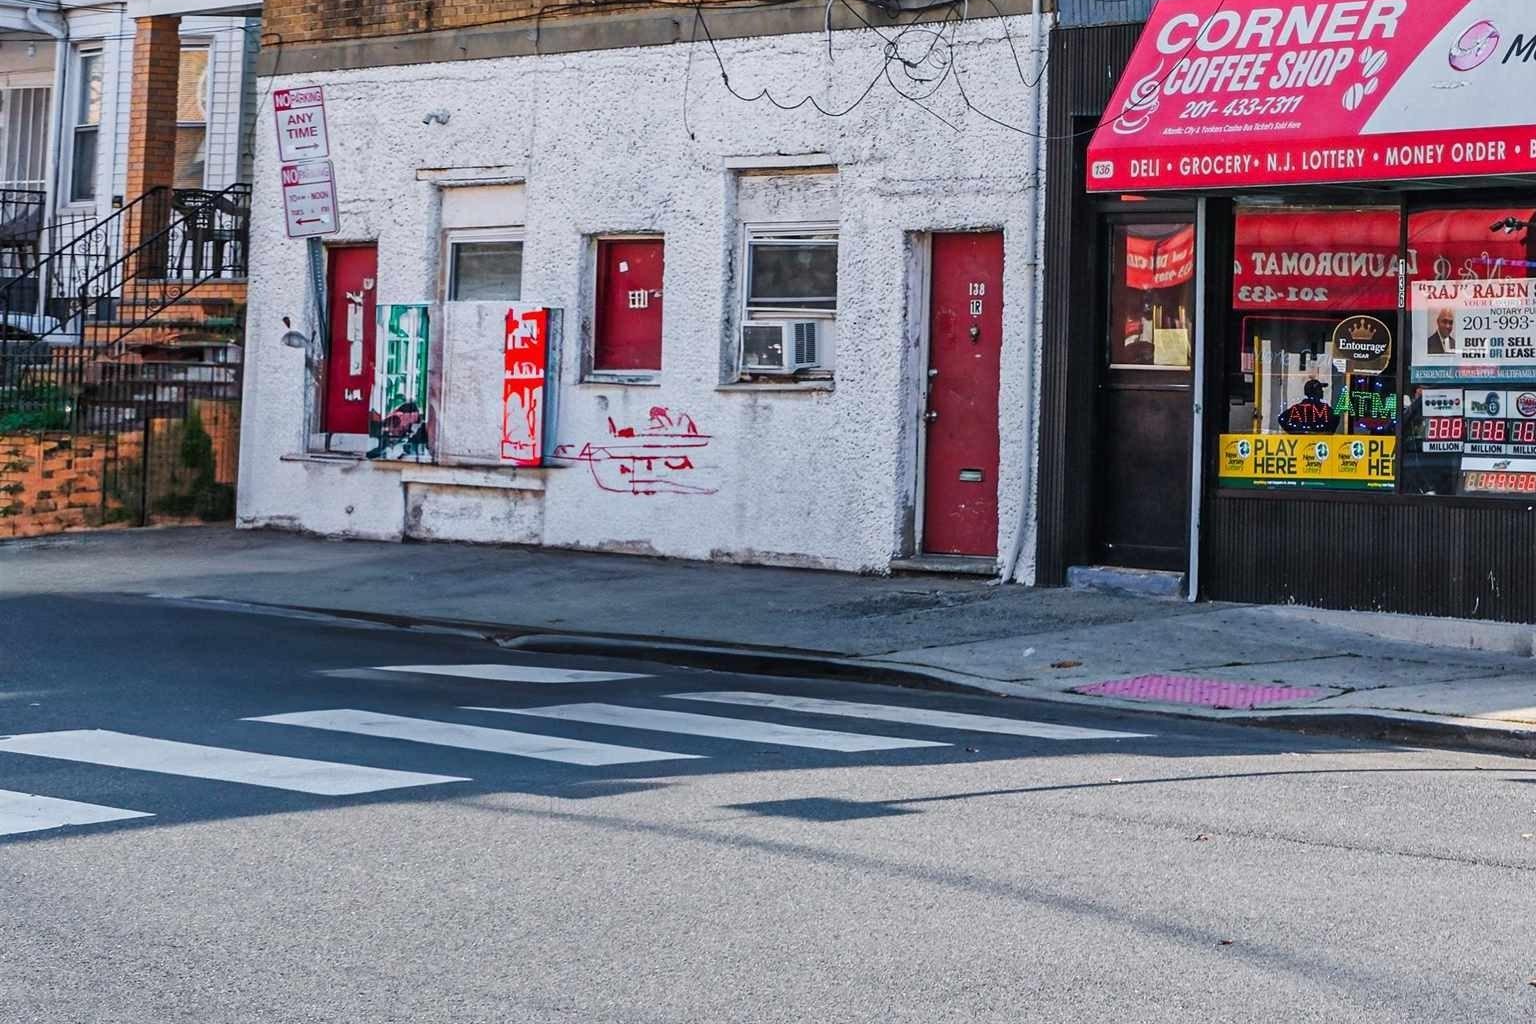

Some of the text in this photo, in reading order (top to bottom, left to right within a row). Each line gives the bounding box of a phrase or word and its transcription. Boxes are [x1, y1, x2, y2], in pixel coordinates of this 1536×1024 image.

[1163, 47, 1355, 96] COFFEE SHOP
[276, 91, 322, 108] NO PARKING
[1222, 95, 1304, 117] 433-7311
[288, 113, 314, 126] ANY
[286, 126, 318, 140] TIME
[1130, 158, 1160, 177] DELI
[1179, 154, 1250, 176] GROCERY
[1267, 152, 1296, 172] N.J.
[1301, 148, 1365, 170] LOTTERY
[1385, 143, 1444, 166] MONEY
[1451, 139, 1506, 162] ORDER
[282, 168, 298, 184] NO
[1093, 163, 1112, 176] 136
[969, 282, 985, 296] 138
[1473, 282, 1529, 299] RAJEN
[1490, 308, 1522, 316] NOTARY
[1339, 338, 1387, 354] Entourage
[1464, 337, 1533, 347] BUY OR SELL
[1489, 349, 1503, 358] OR
[1505, 348, 1536, 358] LEASE
[1333, 385, 1398, 419] ATM
[1290, 404, 1329, 422] ATM
[1254, 439, 1298, 456] PLAY
[1429, 443, 1460, 451] MILLION
[1471, 444, 1502, 453] MILLION
[1254, 457, 1297, 475] HERE
[1341, 460, 1358, 468] Jersey
[1368, 459, 1395, 476] HE
